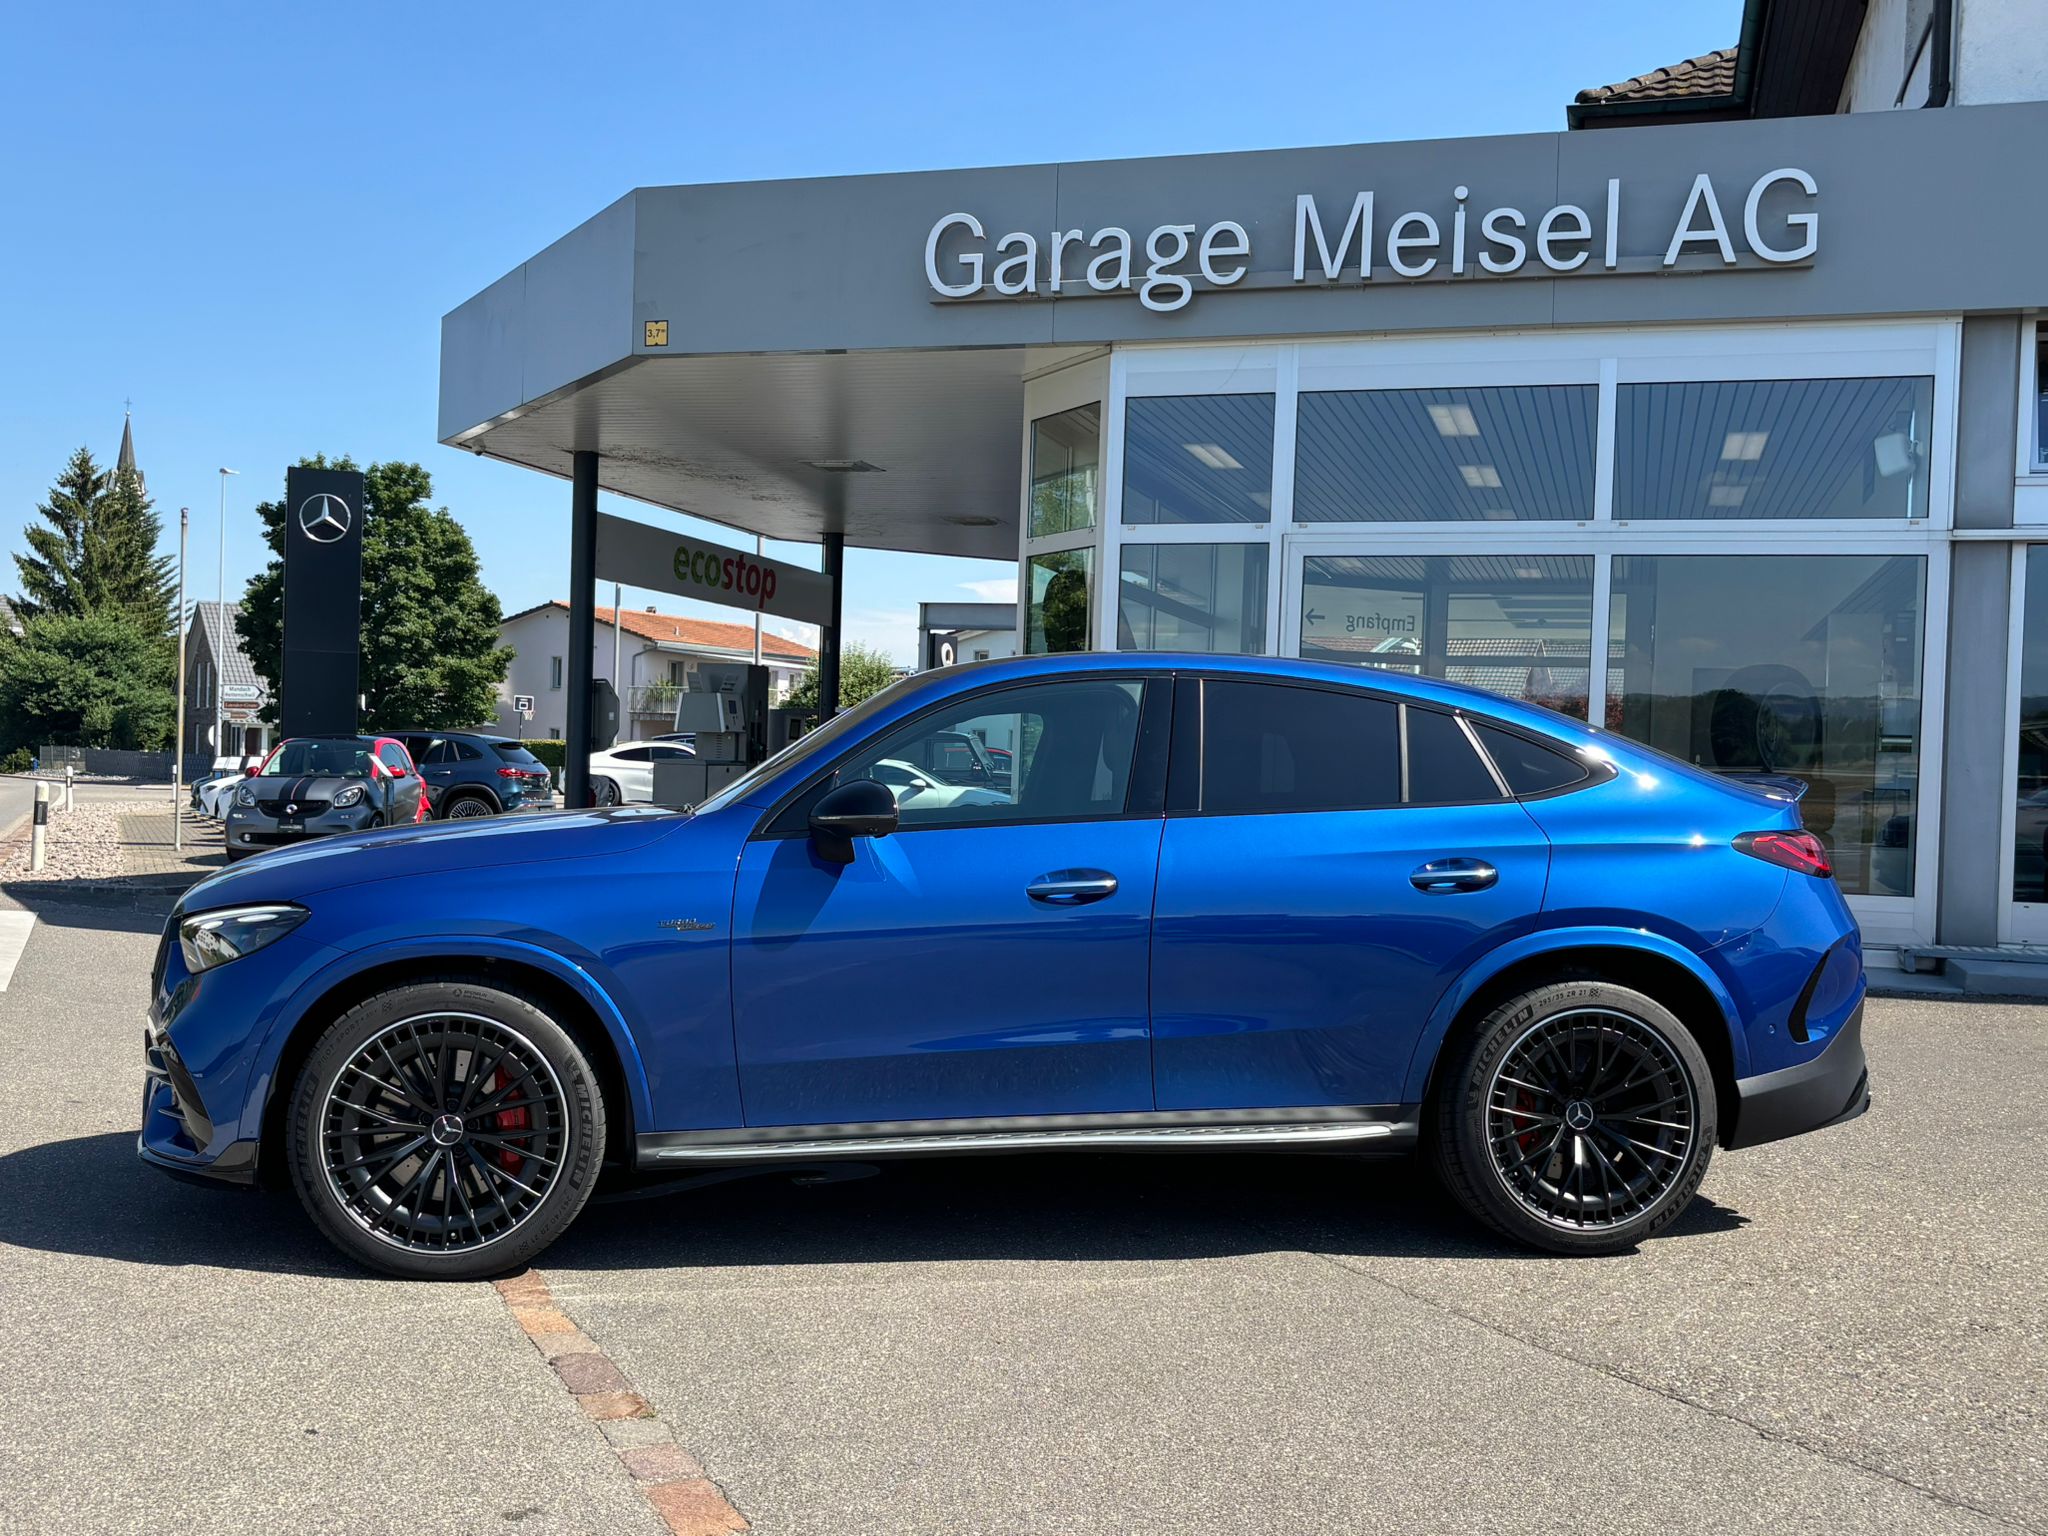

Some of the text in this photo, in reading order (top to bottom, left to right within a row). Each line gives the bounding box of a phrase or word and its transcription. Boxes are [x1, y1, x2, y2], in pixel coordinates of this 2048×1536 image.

[924, 166, 1820, 312] Garage Meisel AG
[673, 545, 777, 609] ecostop
[1471, 1007, 1529, 1087] MICHELIN
[296, 1079, 318, 1182] MICHELIN
[571, 1082, 592, 1183] MICHELIN
[1653, 1149, 1708, 1228] MICHELIN
